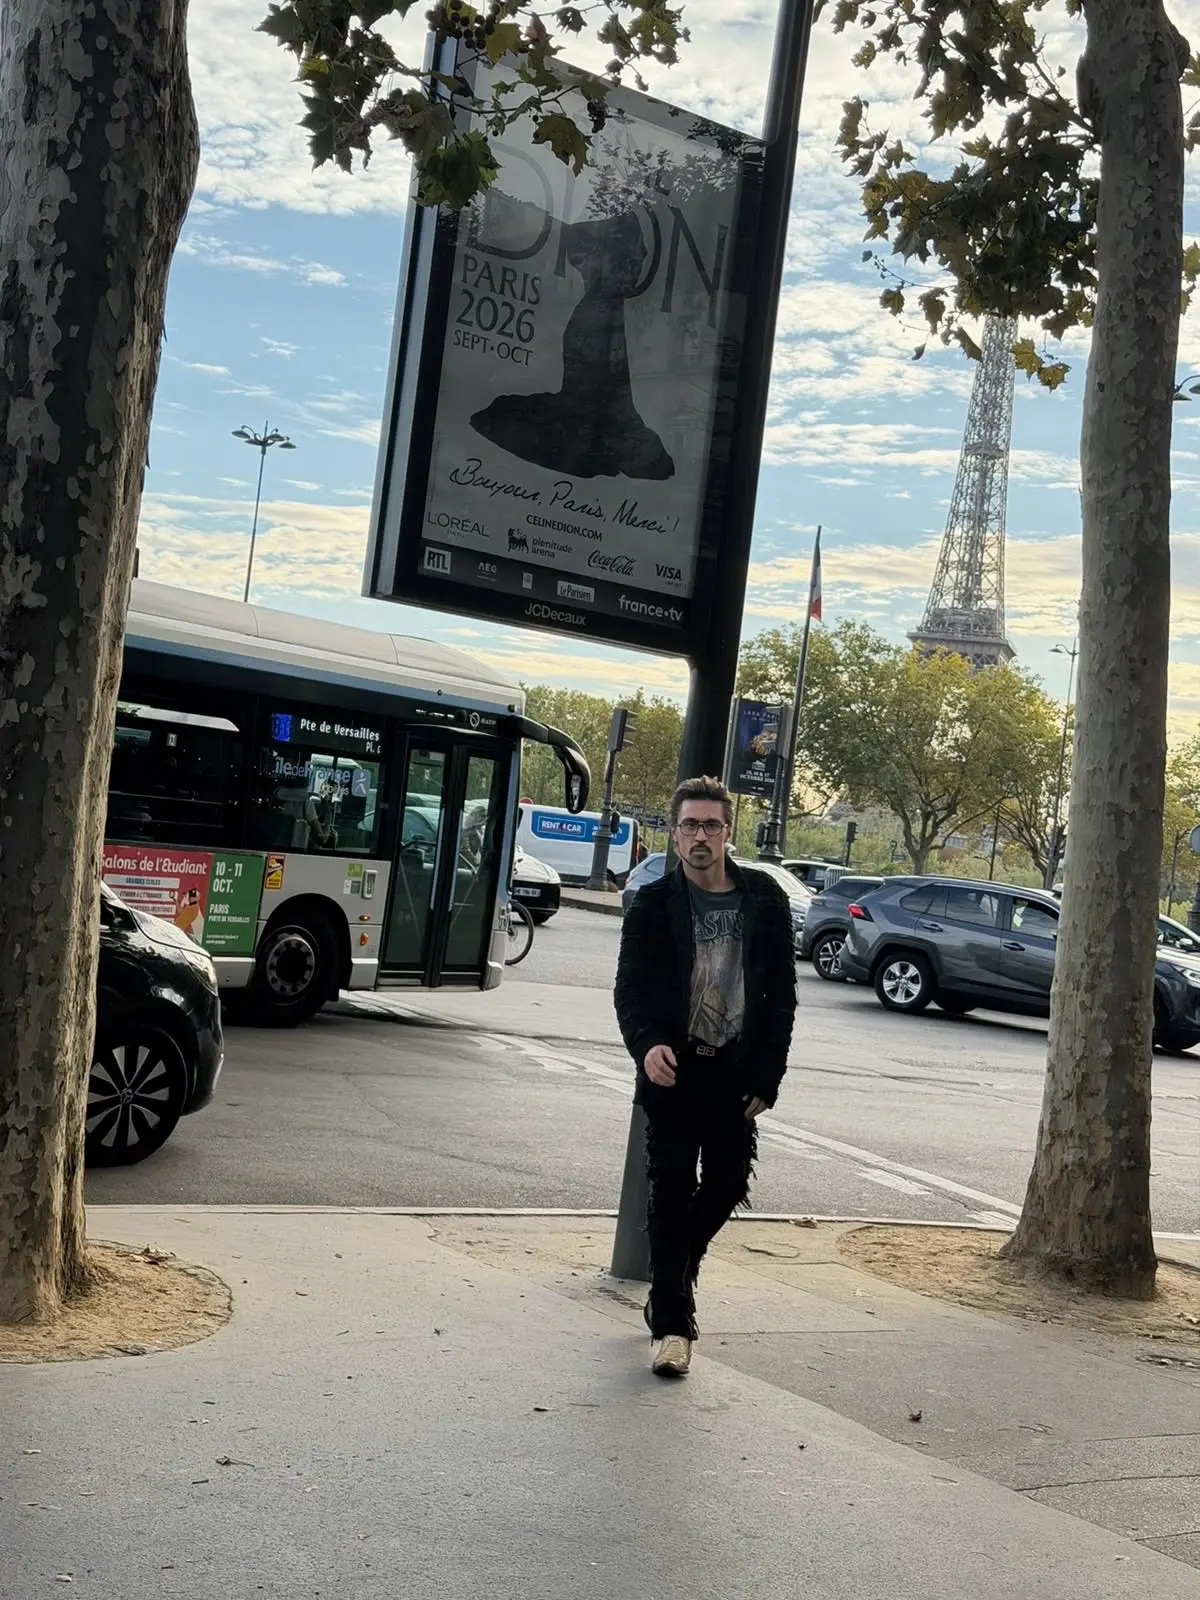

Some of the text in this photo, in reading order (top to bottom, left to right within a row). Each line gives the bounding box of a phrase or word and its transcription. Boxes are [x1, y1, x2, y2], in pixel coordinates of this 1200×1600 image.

[460, 254, 543, 305] PARIS
[456, 288, 536, 344] 2026
[549, 480, 607, 522] Paris,
[525, 514, 603, 542] CELINEDION.COM
[530, 546, 556, 560] arena
[531, 537, 573, 554] plenitude
[426, 550, 449, 570] RTL
[477, 561, 497, 574] AEG
[655, 563, 682, 581] VISA
[567, 583, 593, 602] Parisien
[524, 602, 587, 626] JCDecaux
[300, 718, 316, 731] Pte
[319, 721, 332, 733] de
[334, 724, 380, 741] Versailles
[541, 820, 560, 830] RENT
[567, 824, 582, 832] CAR
[139, 855, 154, 872] de
[215, 861, 224, 877] 10
[234, 862, 243, 877] 11
[212, 877, 234, 894] OCT.
[209, 903, 230, 914] PARIS
